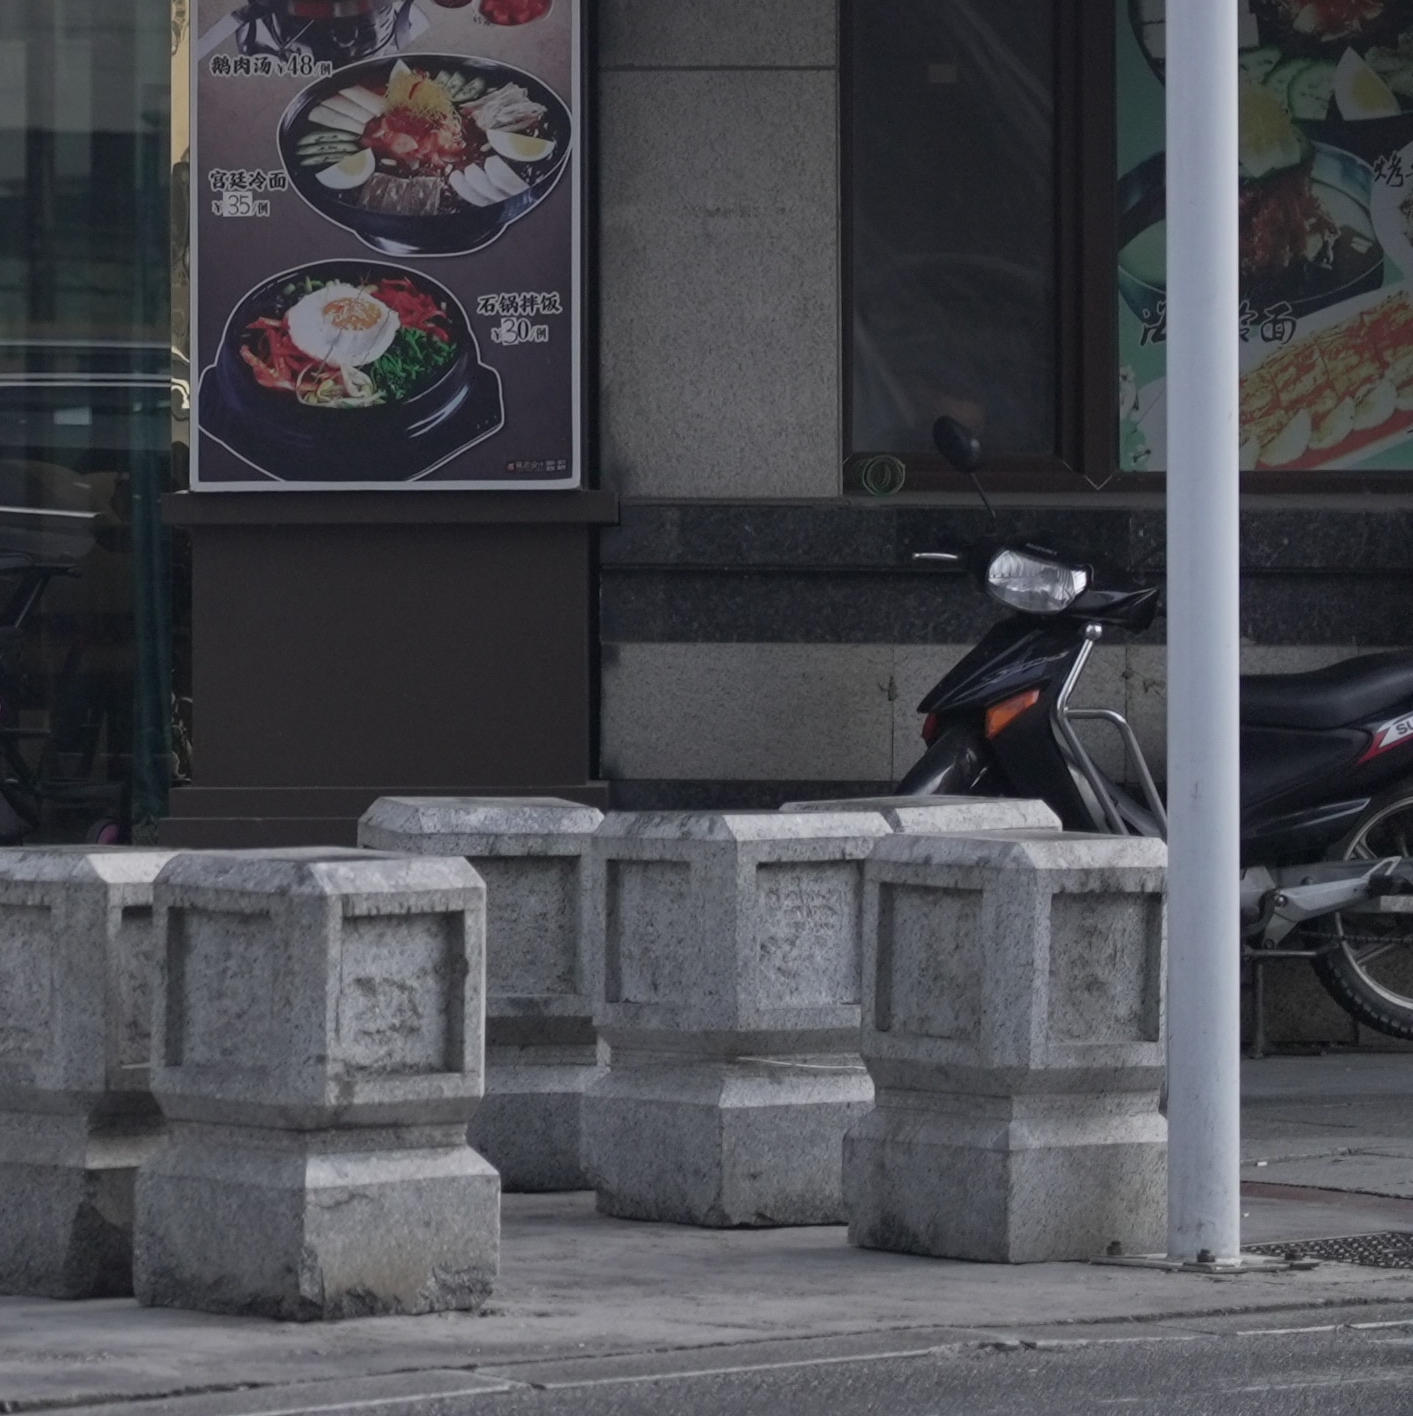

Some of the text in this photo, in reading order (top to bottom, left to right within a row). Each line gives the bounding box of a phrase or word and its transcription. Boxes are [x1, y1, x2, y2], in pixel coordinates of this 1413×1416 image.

[211, 56, 271, 75] 鹅肉汤
[210, 170, 286, 189] 宫廷冷面
[479, 294, 561, 314] 石锅拌饭
